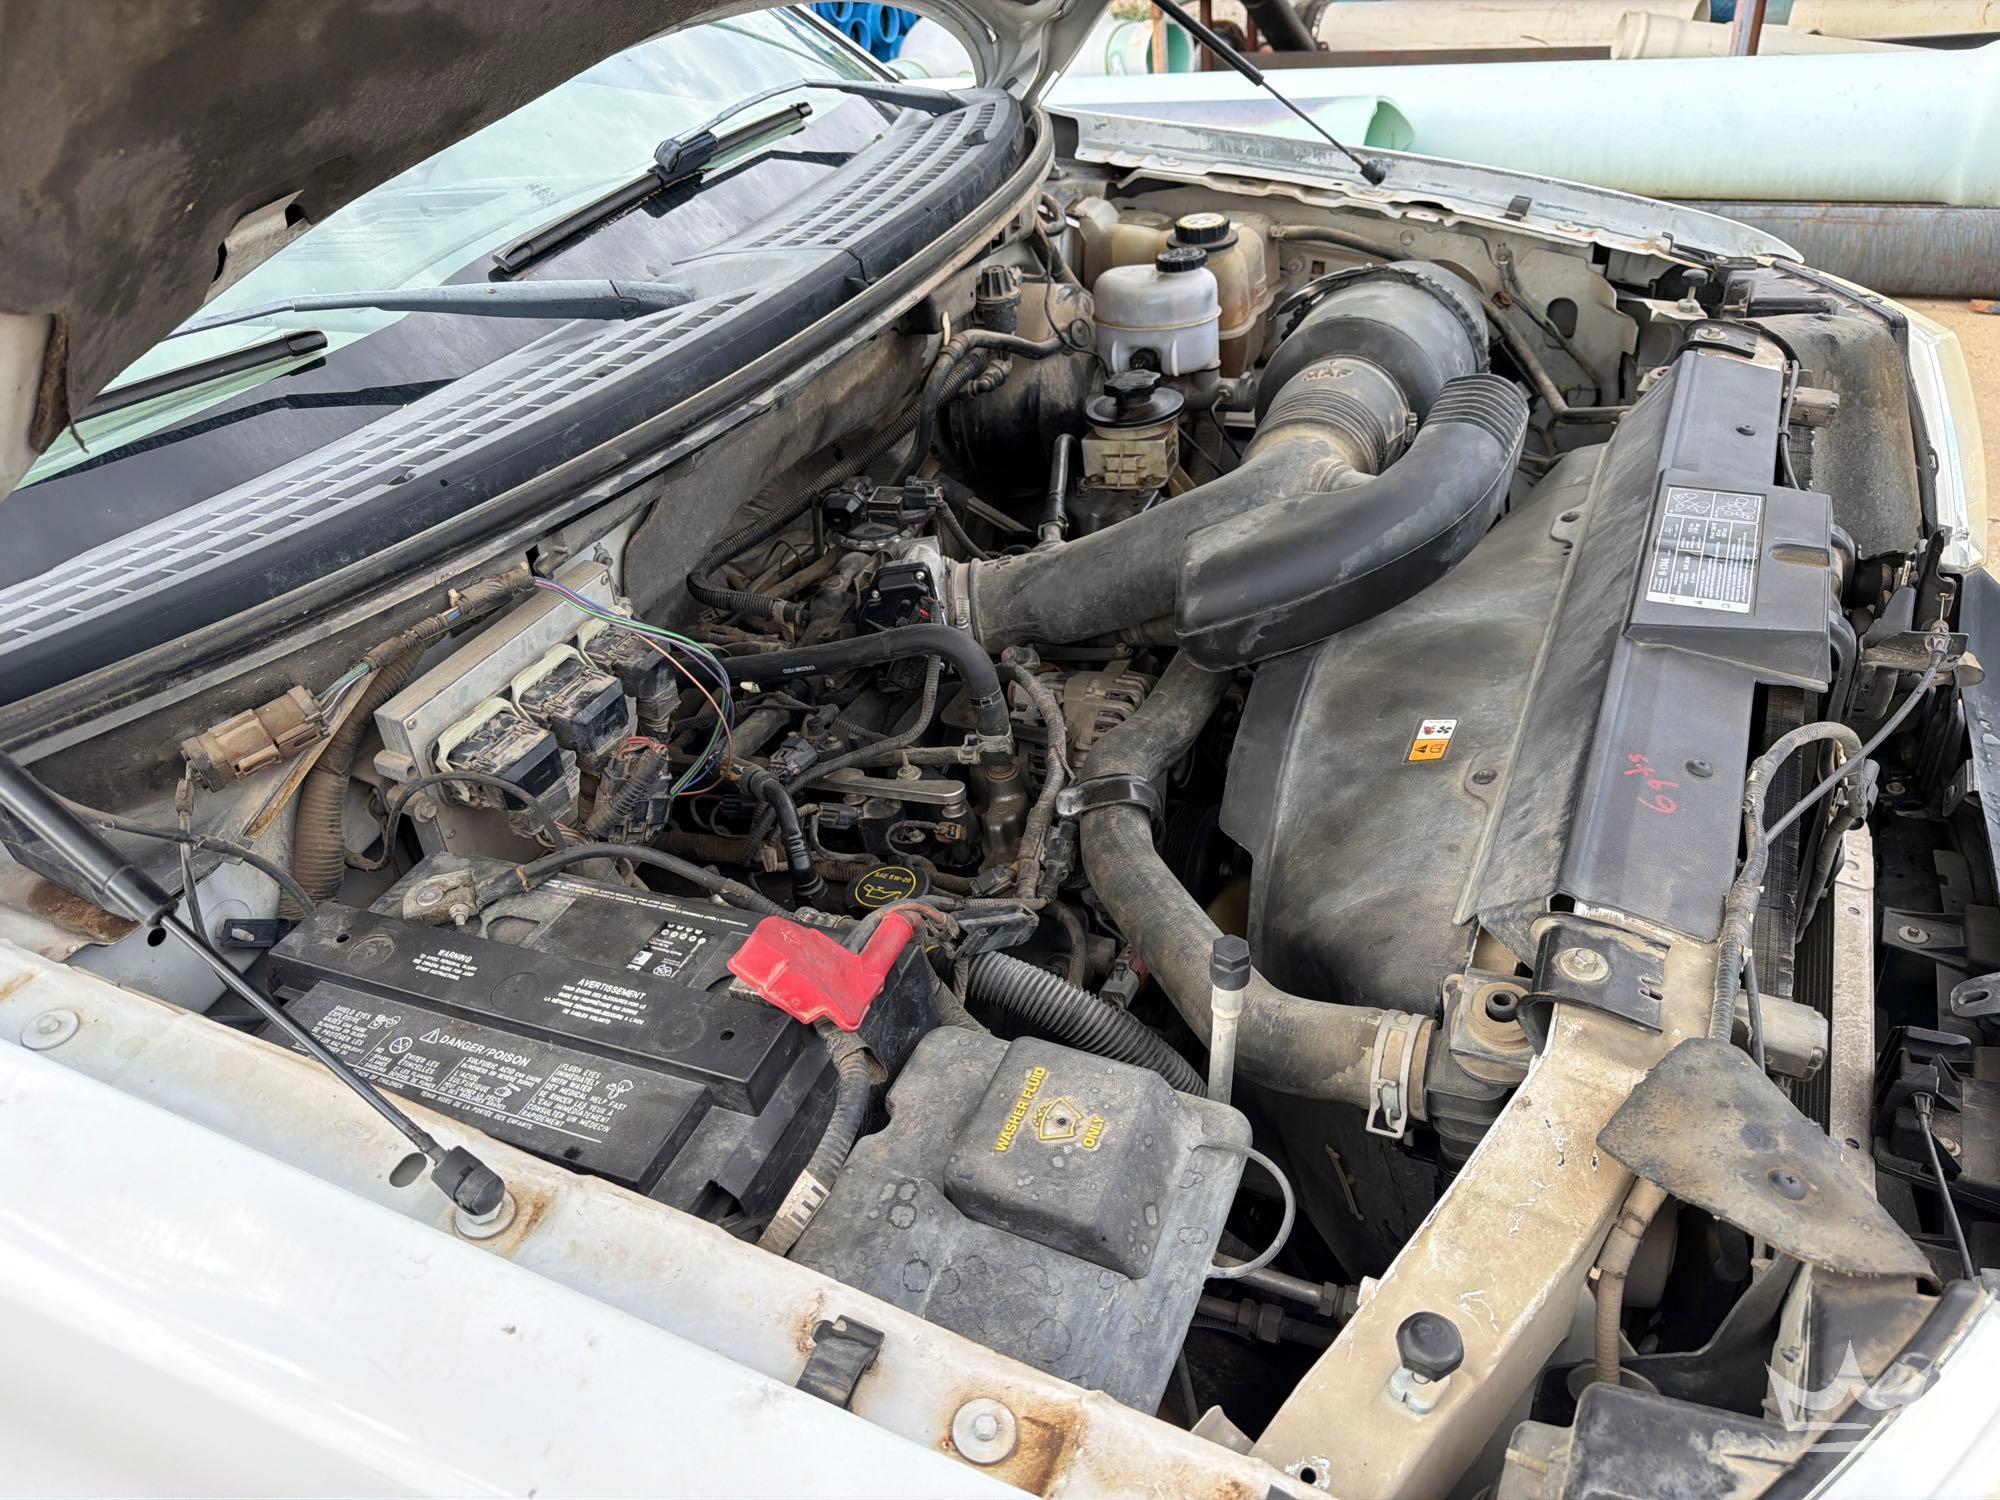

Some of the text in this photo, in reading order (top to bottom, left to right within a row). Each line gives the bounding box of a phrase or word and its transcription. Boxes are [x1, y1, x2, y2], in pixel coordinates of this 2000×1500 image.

[874, 872, 888, 880] SAE
[437, 949, 473, 963] WARNING
[577, 978, 647, 1000] AVERTISSEMENT
[334, 1005, 372, 1020] SHIELD EYES
[440, 1035, 531, 1067] DANGER/POISON
[426, 1060, 441, 1068] LES
[466, 1057, 499, 1070] SULFURIC
[499, 1066, 516, 1075] ACID
[561, 1063, 602, 1079] FLUSH EYES
[449, 1076, 491, 1093] SULFURIQUE
[550, 1077, 593, 1093] WITH WATER
[556, 1070, 601, 1087] IMMEDIATELY
[538, 1090, 549, 1098] SE
[549, 1093, 574, 1105] RINCER
[573, 1100, 588, 1110] LES
[589, 1104, 607, 1114] YEUX
[544, 1083, 628, 1111] GET MEDICAL HELP FAST
[526, 1103, 566, 1119] CONSULTER
[566, 1115, 579, 1123] UN
[996, 1066, 1046, 1152] WASHER FLUID
[520, 1110, 566, 1128] RAPIDEMENT
[1083, 1116, 1105, 1148] ONLY
